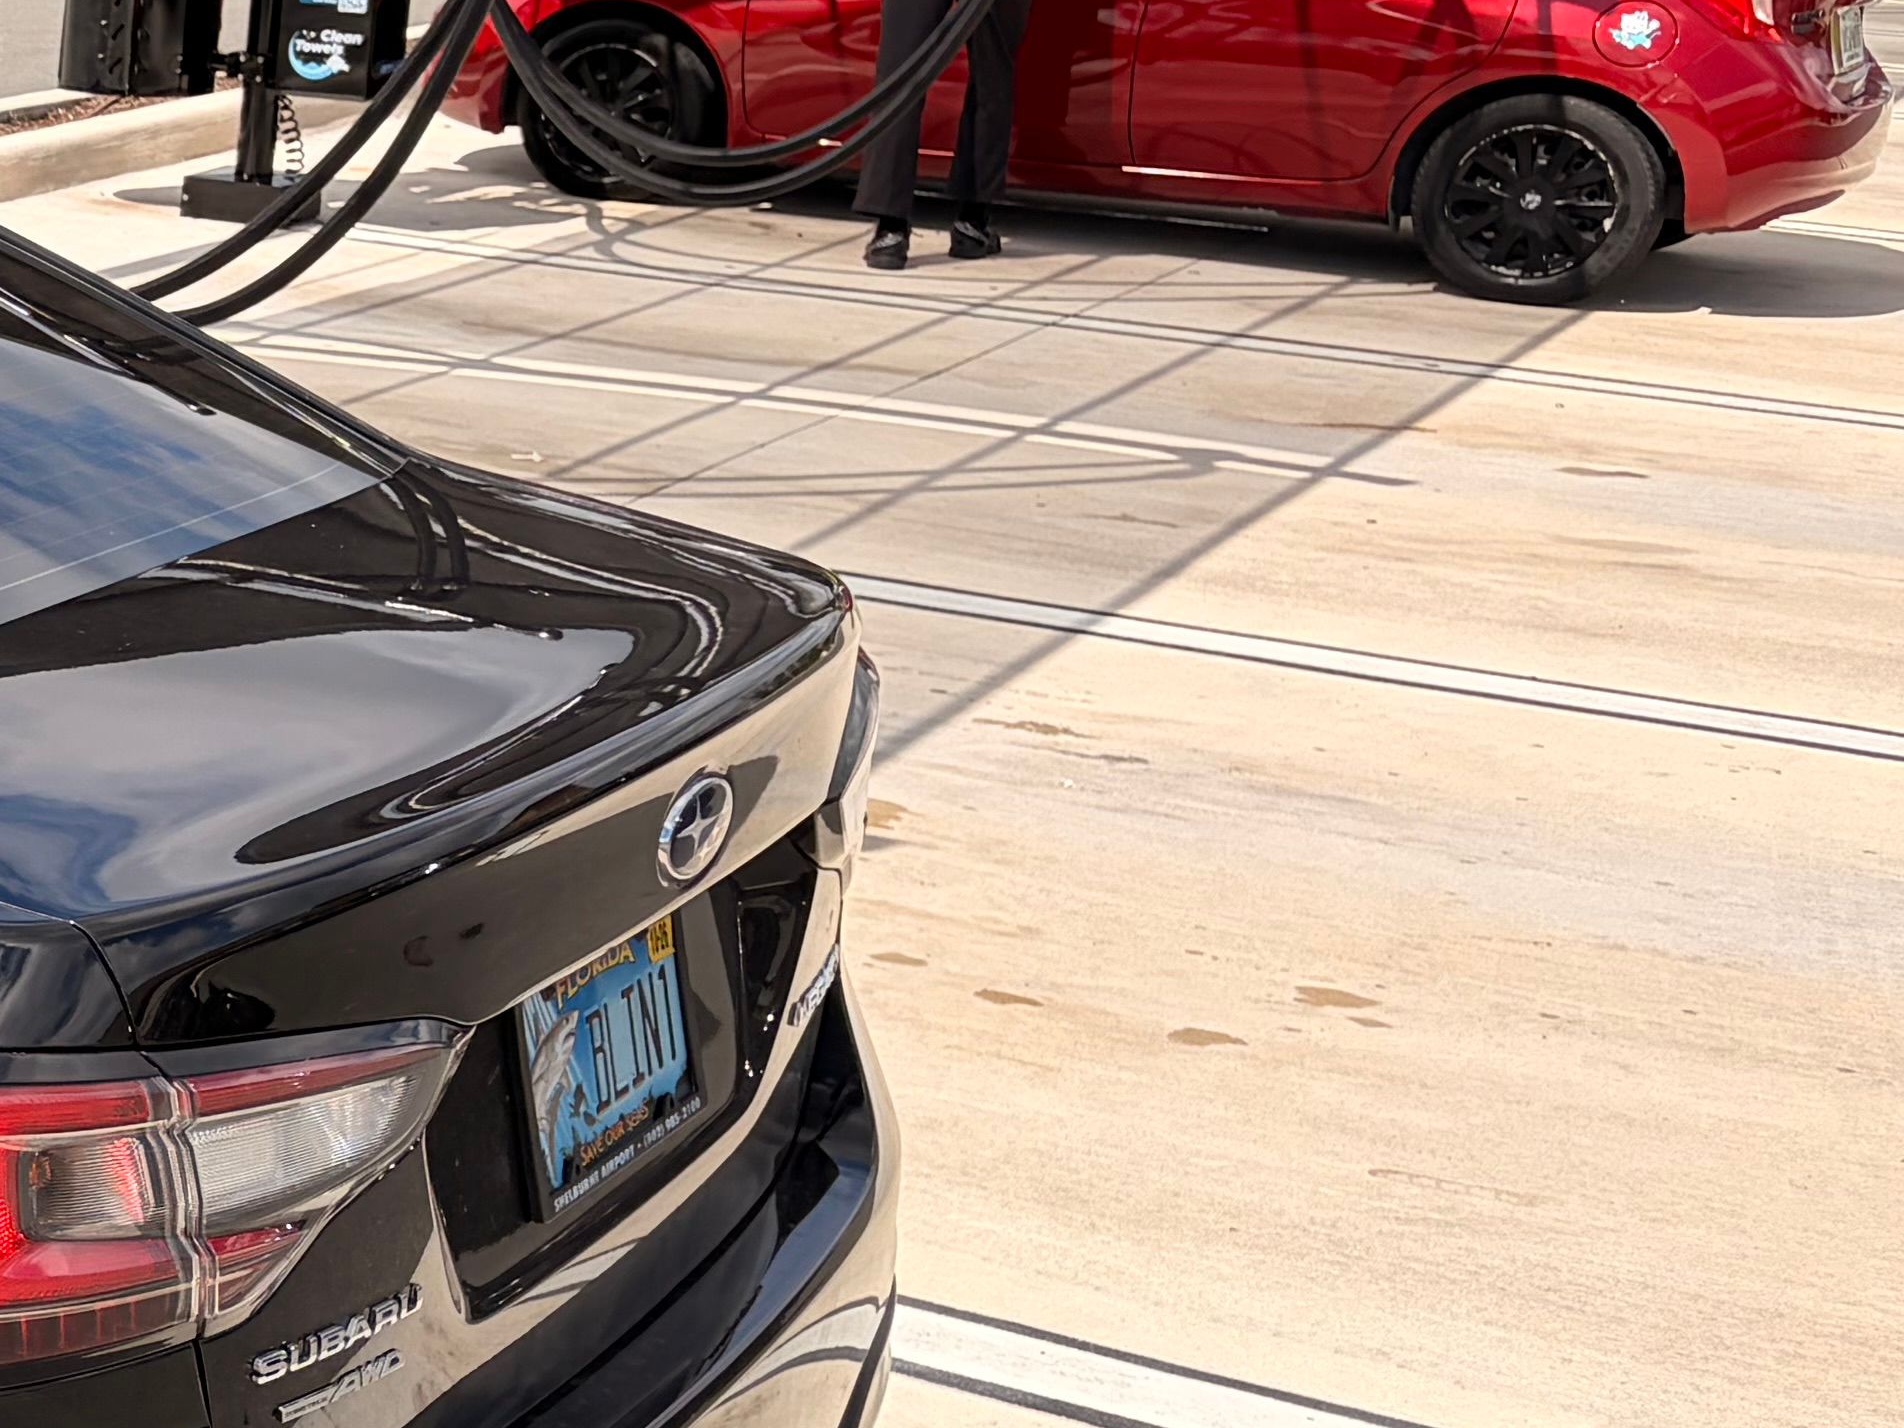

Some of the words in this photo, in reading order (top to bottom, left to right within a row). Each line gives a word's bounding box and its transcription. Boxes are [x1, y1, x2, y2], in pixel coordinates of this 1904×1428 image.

[295, 37, 345, 56] Towels
[320, 28, 363, 47] Clean
[555, 944, 636, 1010] FLORIDA
[579, 1136, 605, 1168] SAVE
[601, 1144, 635, 1179] AIRPORT
[248, 1282, 425, 1386] SUBARU
[329, 1348, 406, 1404] AWD
